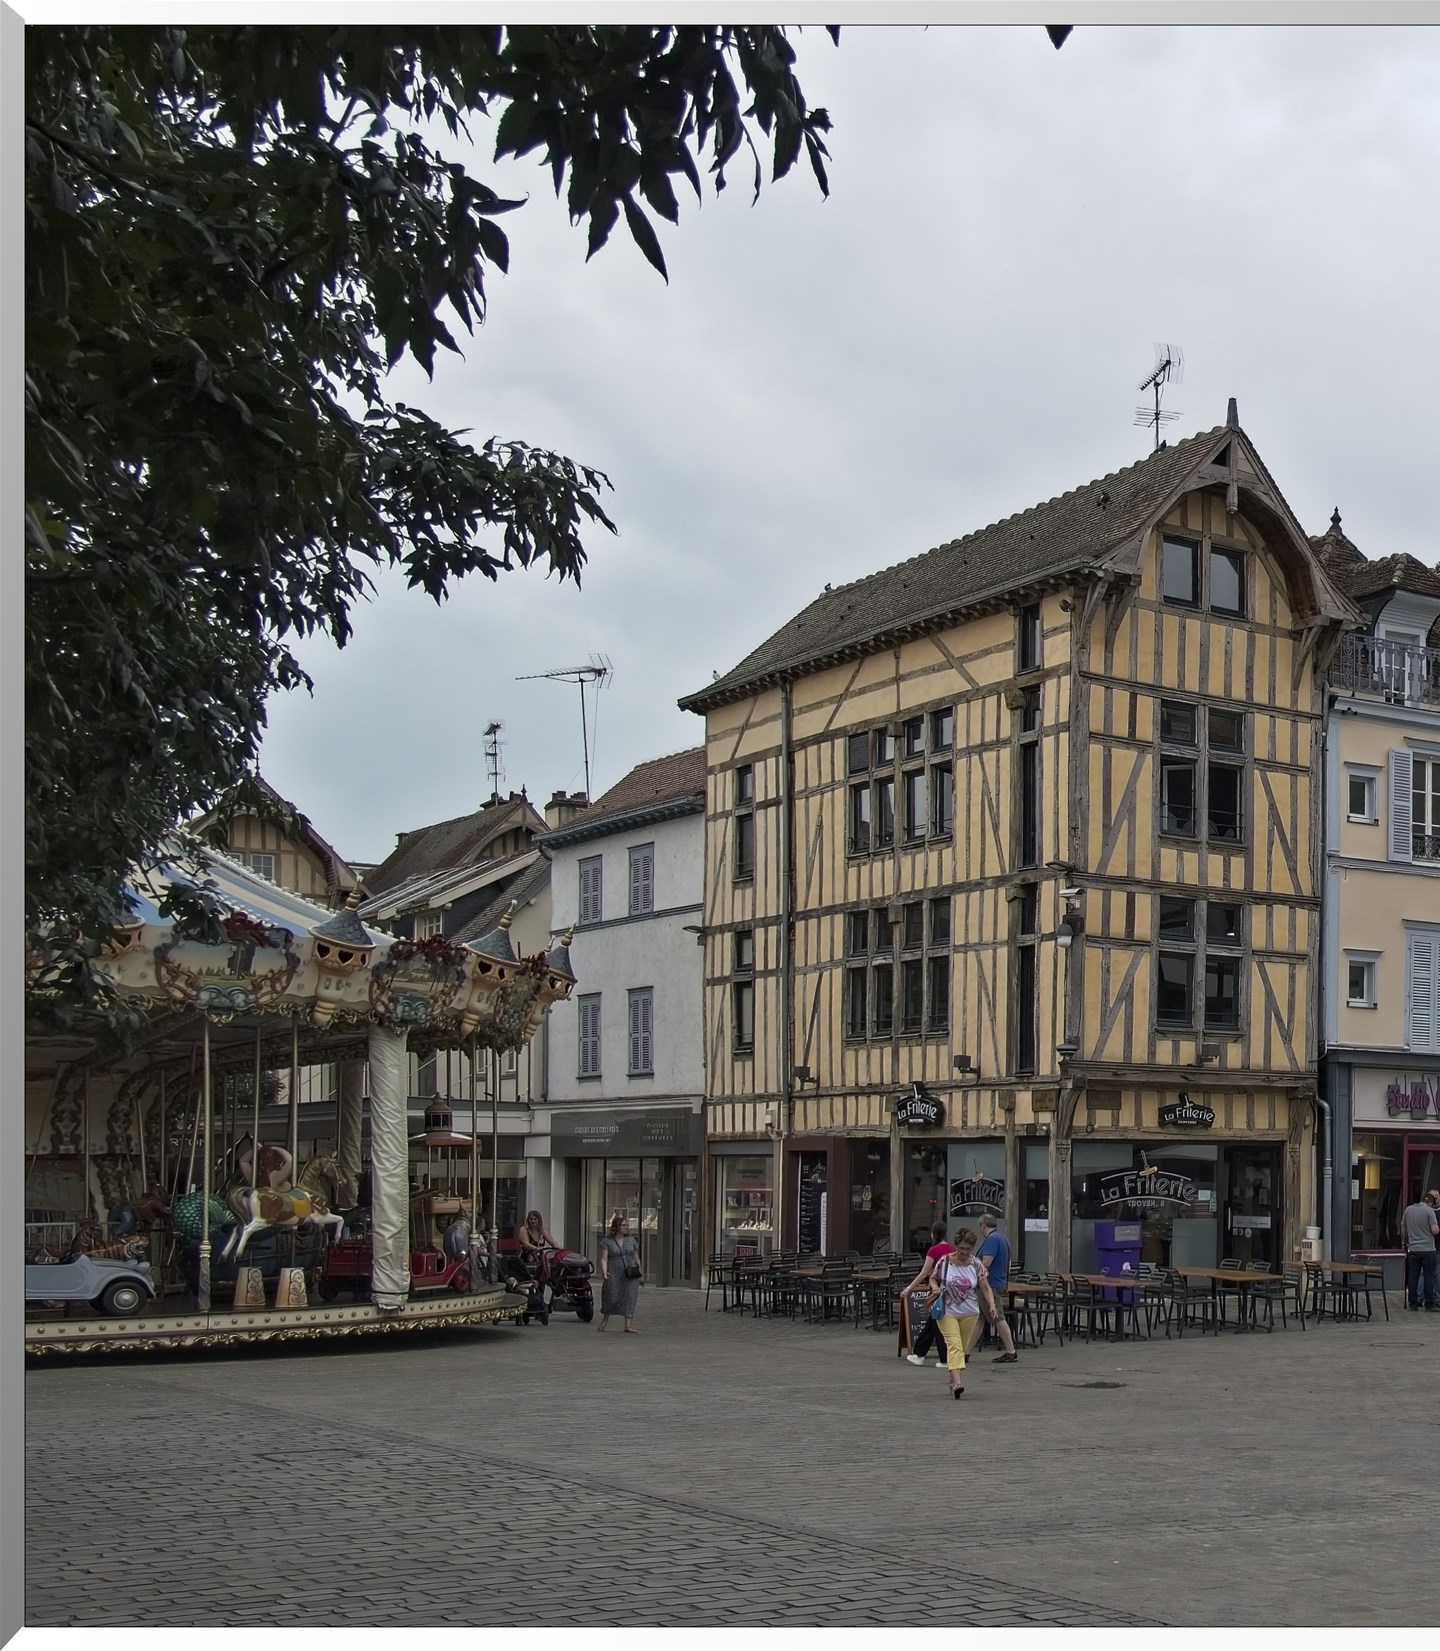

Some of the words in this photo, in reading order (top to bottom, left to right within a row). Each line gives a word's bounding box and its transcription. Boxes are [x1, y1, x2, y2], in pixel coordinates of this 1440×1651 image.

[898, 1109, 906, 1119] La
[907, 1101, 937, 1118] Friterie
[1176, 1107, 1213, 1121] Friterie
[950, 1193, 962, 1207] La
[963, 1181, 1006, 1207] Friterie
[1100, 1187, 1121, 1202] La
[1124, 1175, 1198, 1201] Friterie
